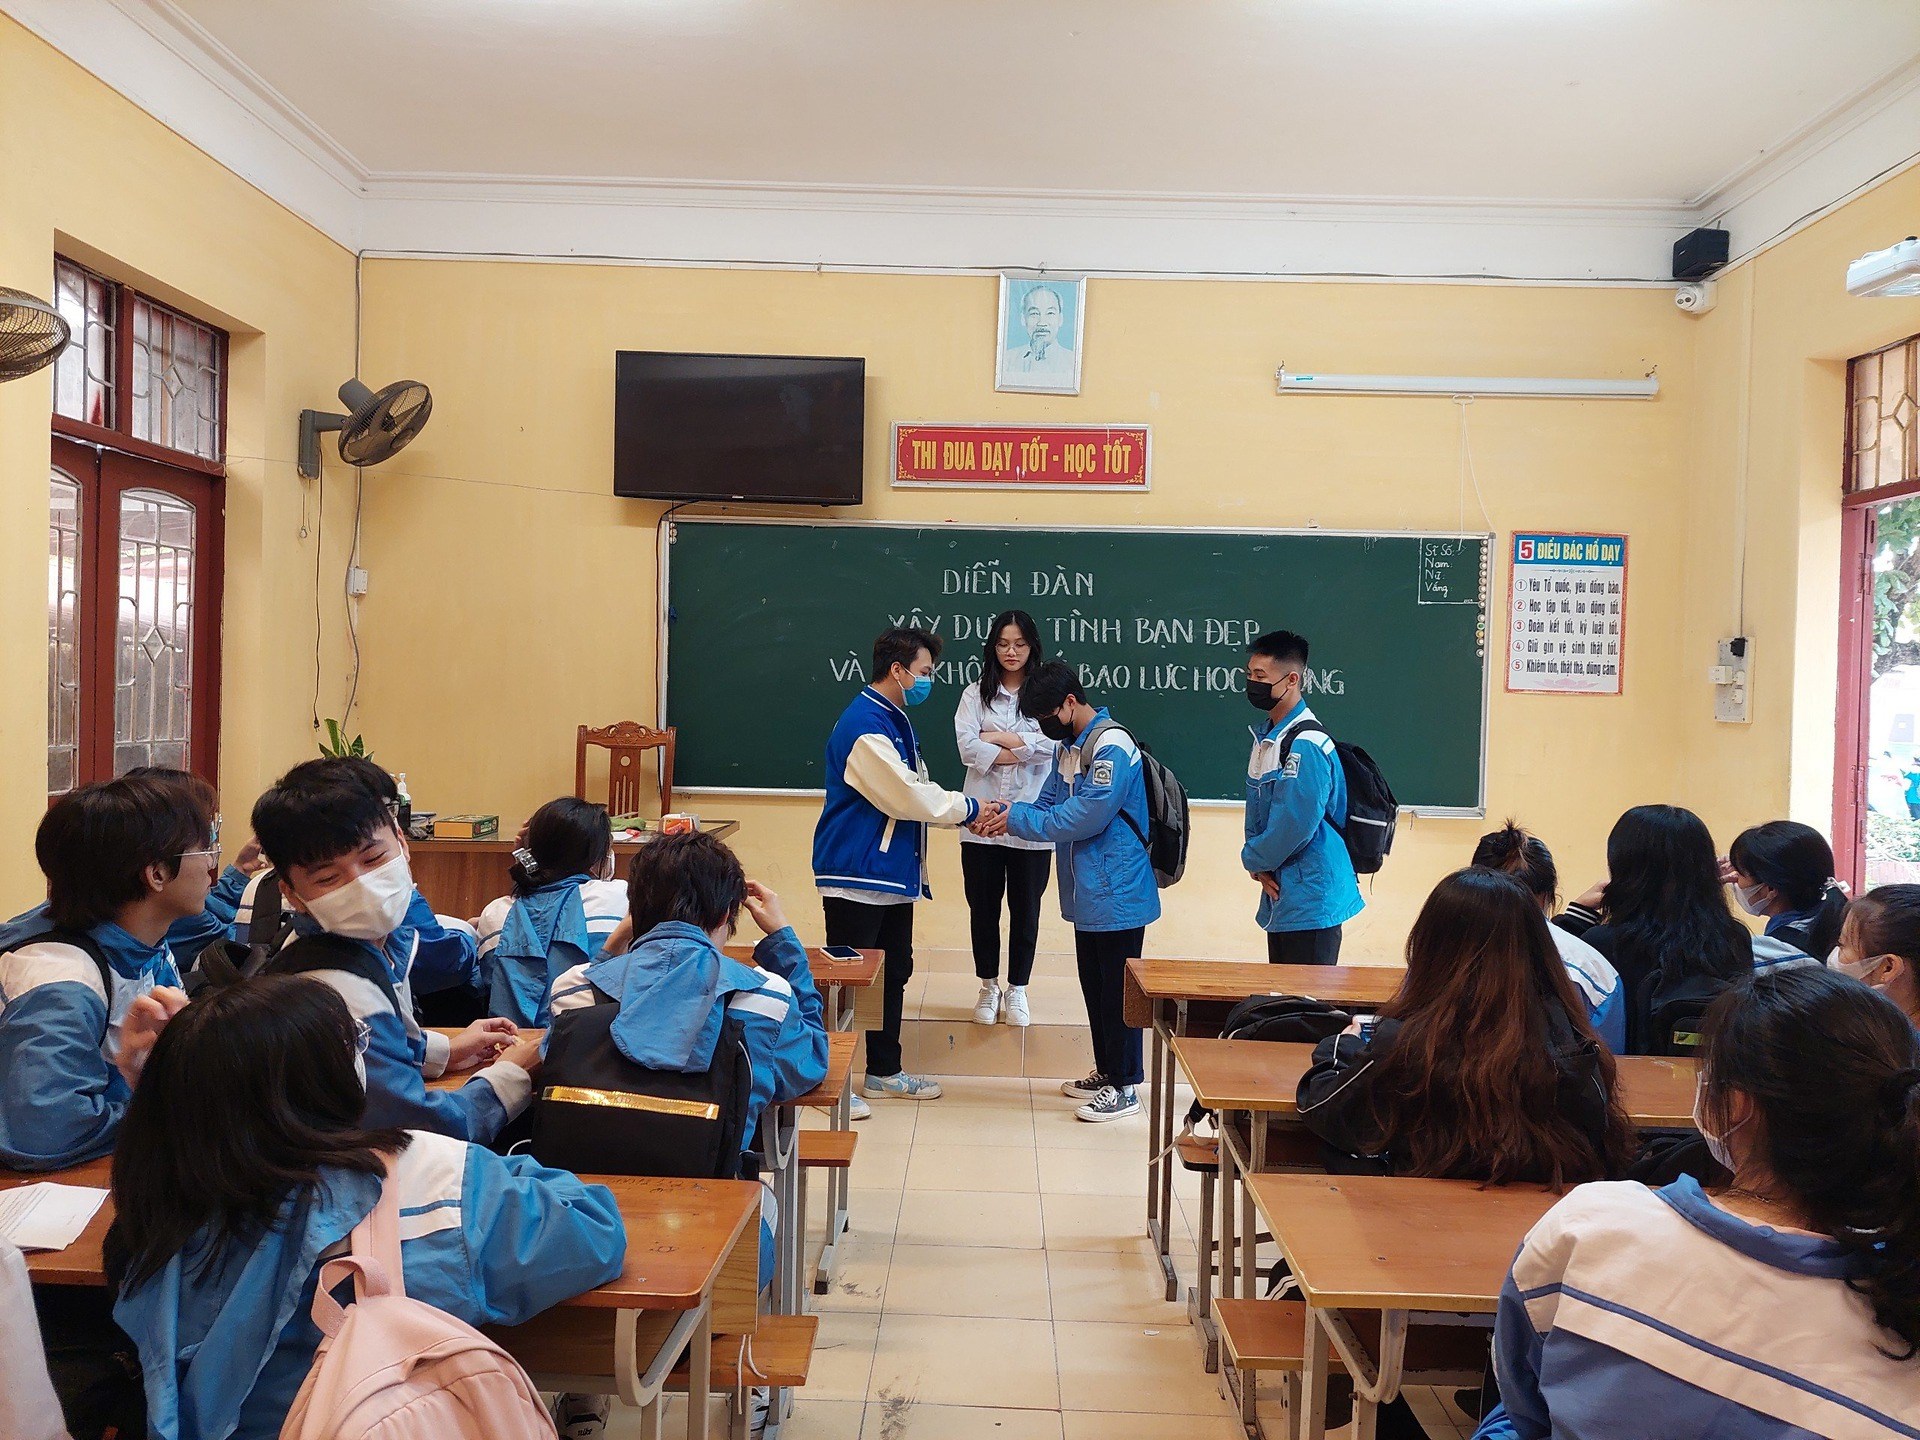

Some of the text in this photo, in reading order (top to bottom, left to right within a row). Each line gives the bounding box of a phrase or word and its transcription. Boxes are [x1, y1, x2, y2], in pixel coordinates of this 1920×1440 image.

[912, 440, 937, 470] THI
[943, 441, 976, 471] ĐUA
[981, 442, 1013, 477] DẠY
[1020, 435, 1049, 473] TỐT
[1064, 444, 1097, 478] HỌC
[1103, 437, 1132, 474] TỐT
[1520, 541, 1533, 559] 5
[1562, 540, 1583, 560] BÁC
[1585, 538, 1599, 561] HỒ
[1601, 544, 1621, 565] DẠY
[1029, 564, 1094, 596] ĐÀN
[1529, 578, 1540, 592] Yêu
[1575, 579, 1586, 595] yêu
[1529, 598, 1541, 615] Học
[1546, 599, 1556, 616] tập
[1575, 600, 1586, 613] lao
[1590, 600, 1606, 617] động
[1046, 608, 1121, 644] TÌNH
[1135, 617, 1193, 648] BẠN
[1203, 618, 1260, 652] ĐẸP
[1528, 619, 1544, 632] Đoàn
[1549, 617, 1560, 634] kết
[1592, 620, 1604, 637] luật
[1559, 640, 1567, 656] vệ
[1571, 640, 1585, 655] sinh
[1590, 641, 1603, 658] thật
[829, 650, 1247, 698] VÀ KHÔ BẠO LỰC HỌC
[1526, 658, 1546, 673] Khiêm
[1560, 660, 1573, 676] thật
